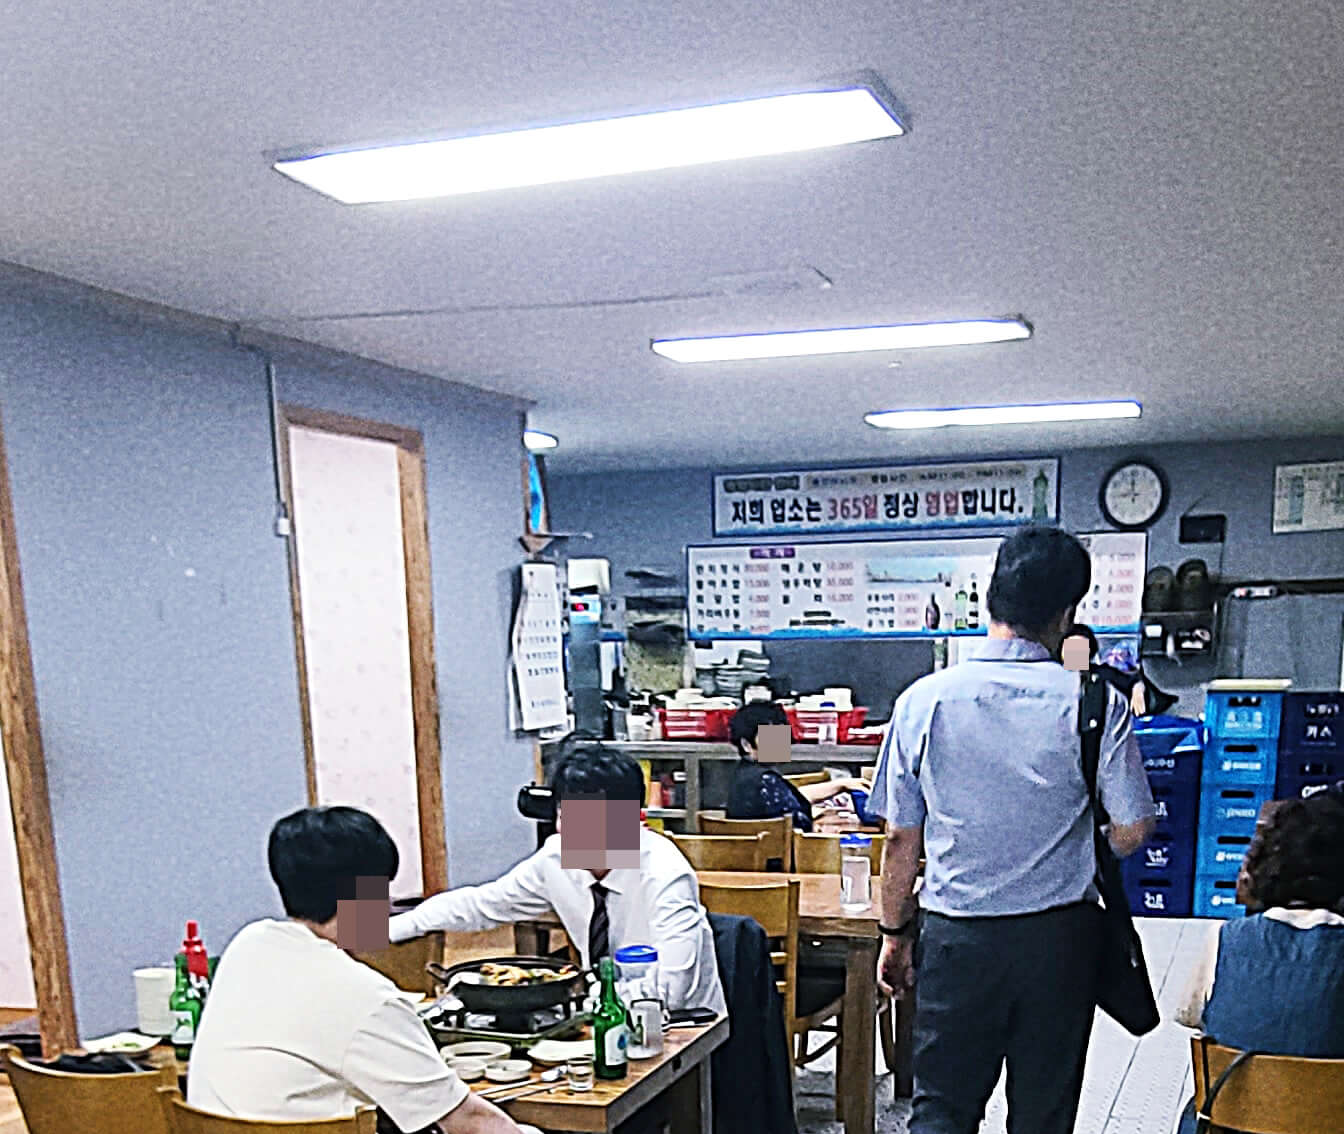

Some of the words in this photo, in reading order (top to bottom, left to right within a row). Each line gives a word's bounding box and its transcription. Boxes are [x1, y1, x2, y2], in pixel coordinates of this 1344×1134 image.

[731, 498, 764, 526] 저희
[770, 496, 822, 524] 업소는
[827, 492, 879, 521] 365일
[883, 491, 919, 520] 정상
[925, 486, 1025, 517] 영업합니다.
